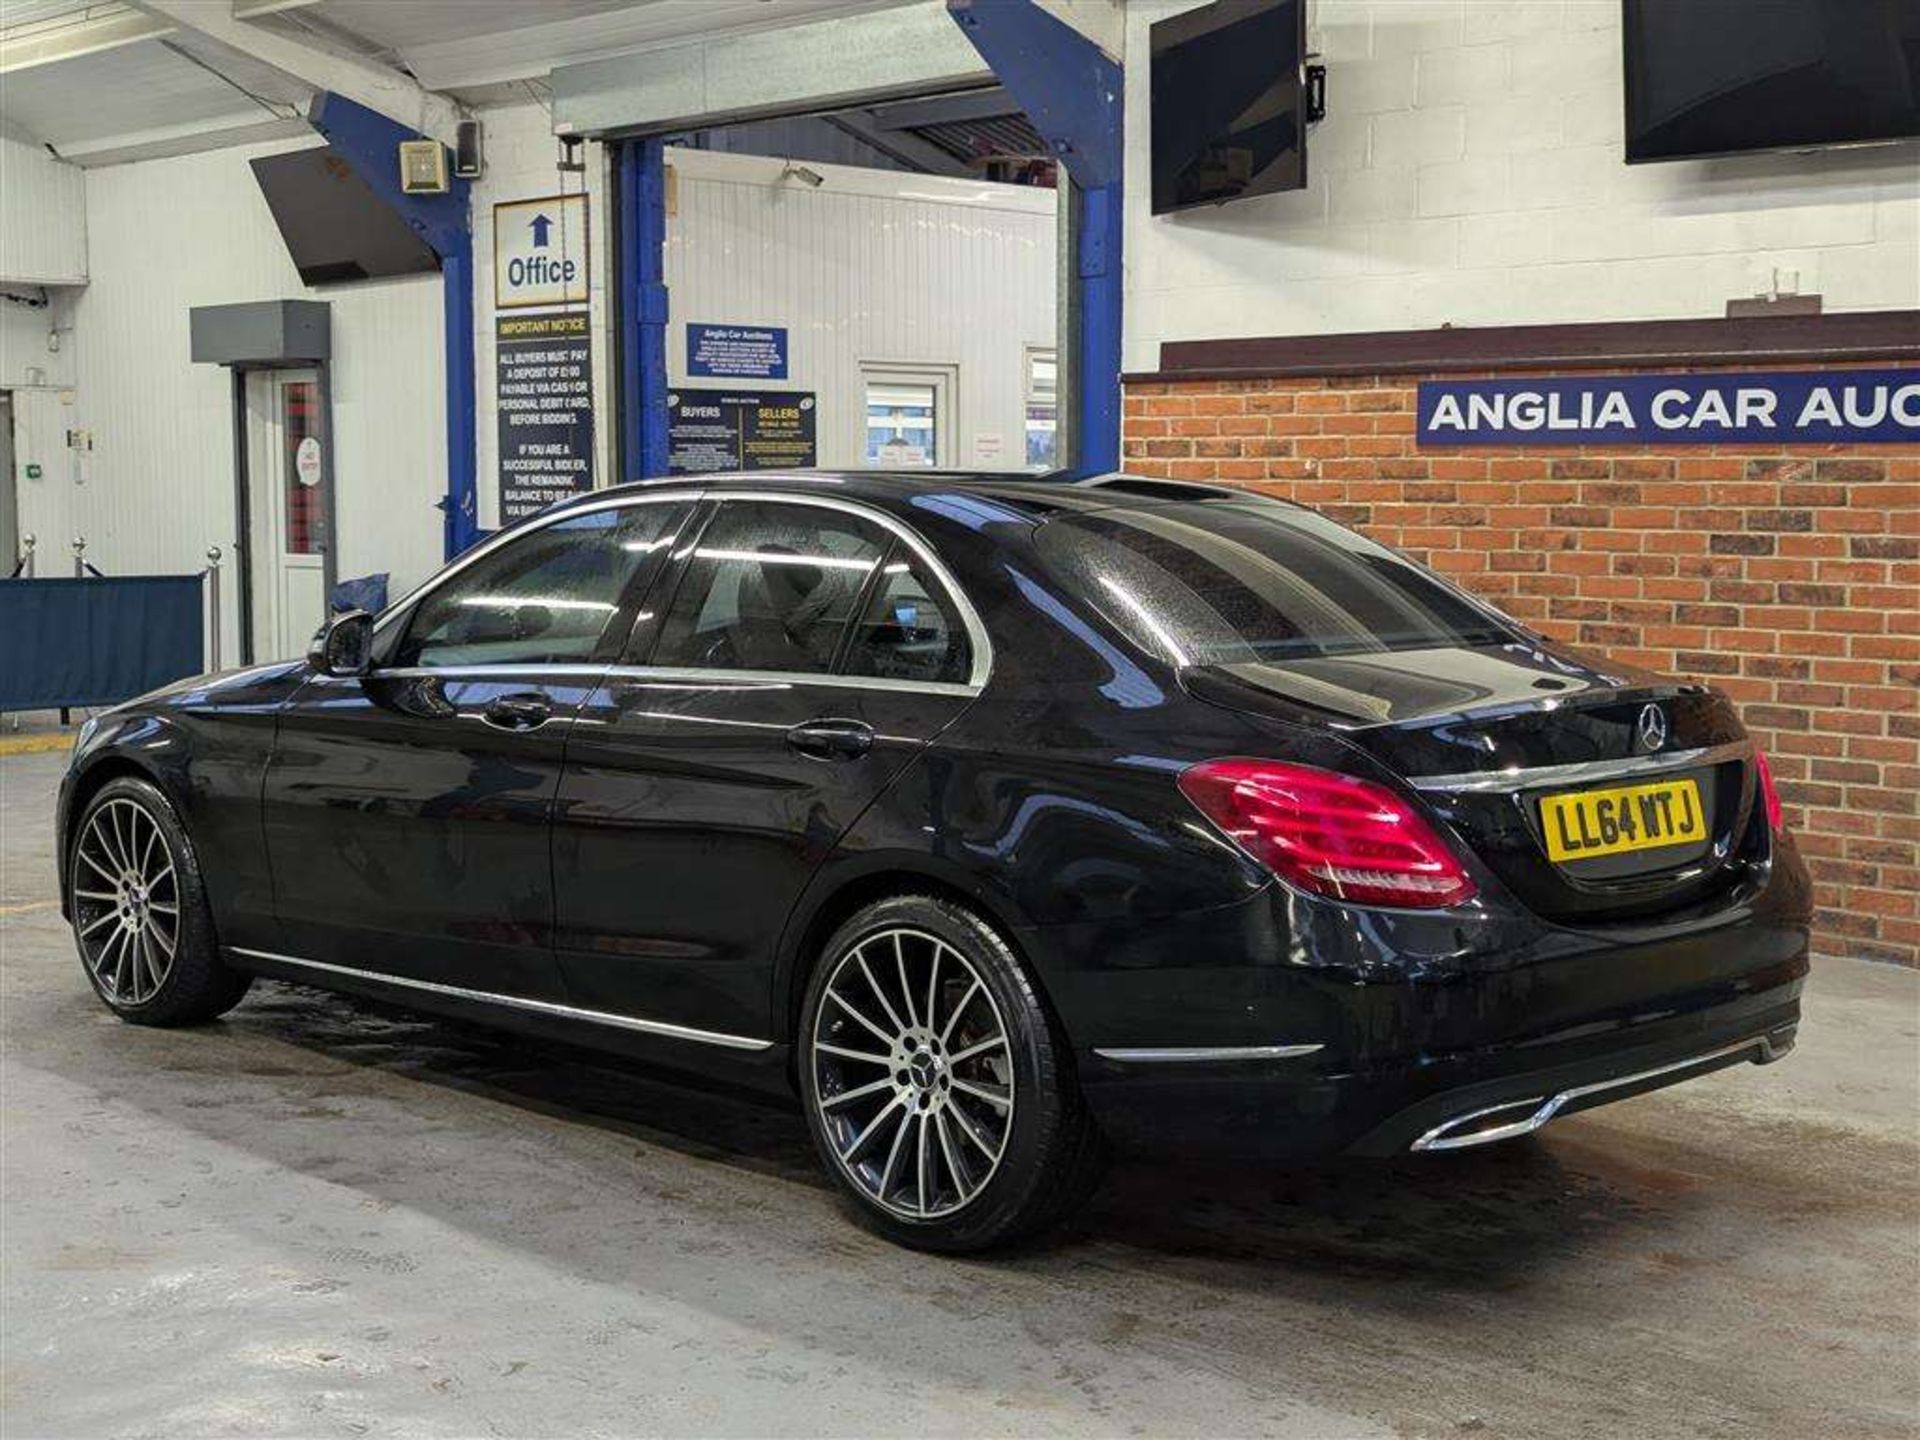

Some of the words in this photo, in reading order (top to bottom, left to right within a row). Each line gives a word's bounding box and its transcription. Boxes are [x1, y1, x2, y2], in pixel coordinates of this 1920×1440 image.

[508, 256, 575, 287] Office
[500, 320, 549, 335] IMPORTANT
[551, 318, 585, 331] NOTICE
[728, 330, 742, 338] Car
[500, 353, 514, 364] ALL
[515, 352, 546, 363] BUYERS
[570, 349, 587, 361] PAY
[506, 369, 513, 378] A
[513, 367, 547, 379] DEPOSIT
[548, 366, 560, 378] OF
[500, 383, 535, 394] PAYABLE
[536, 382, 550, 393] VIA
[575, 381, 588, 392] OR
[499, 398, 539, 410] PERSONAL
[540, 397, 564, 409] DEBIT
[1427, 391, 1636, 430] ANGLIA
[1650, 388, 1778, 429] CAR
[1795, 384, 1920, 428] AUC
[680, 406, 720, 418] BUYERS
[758, 408, 800, 419] SELLERS
[509, 414, 541, 425] BEFORE
[528, 443, 545, 455] YOU
[545, 443, 563, 455] ARE
[563, 444, 570, 454] A
[503, 459, 554, 471] SUCCESSFUL
[514, 474, 530, 486] THE
[505, 490, 541, 502] BALANCE
[543, 490, 554, 501] TO
[554, 490, 566, 501] BE
[506, 505, 520, 517] VIA
[1556, 797, 1636, 851] LL64
[1639, 789, 1695, 838] WTJ
